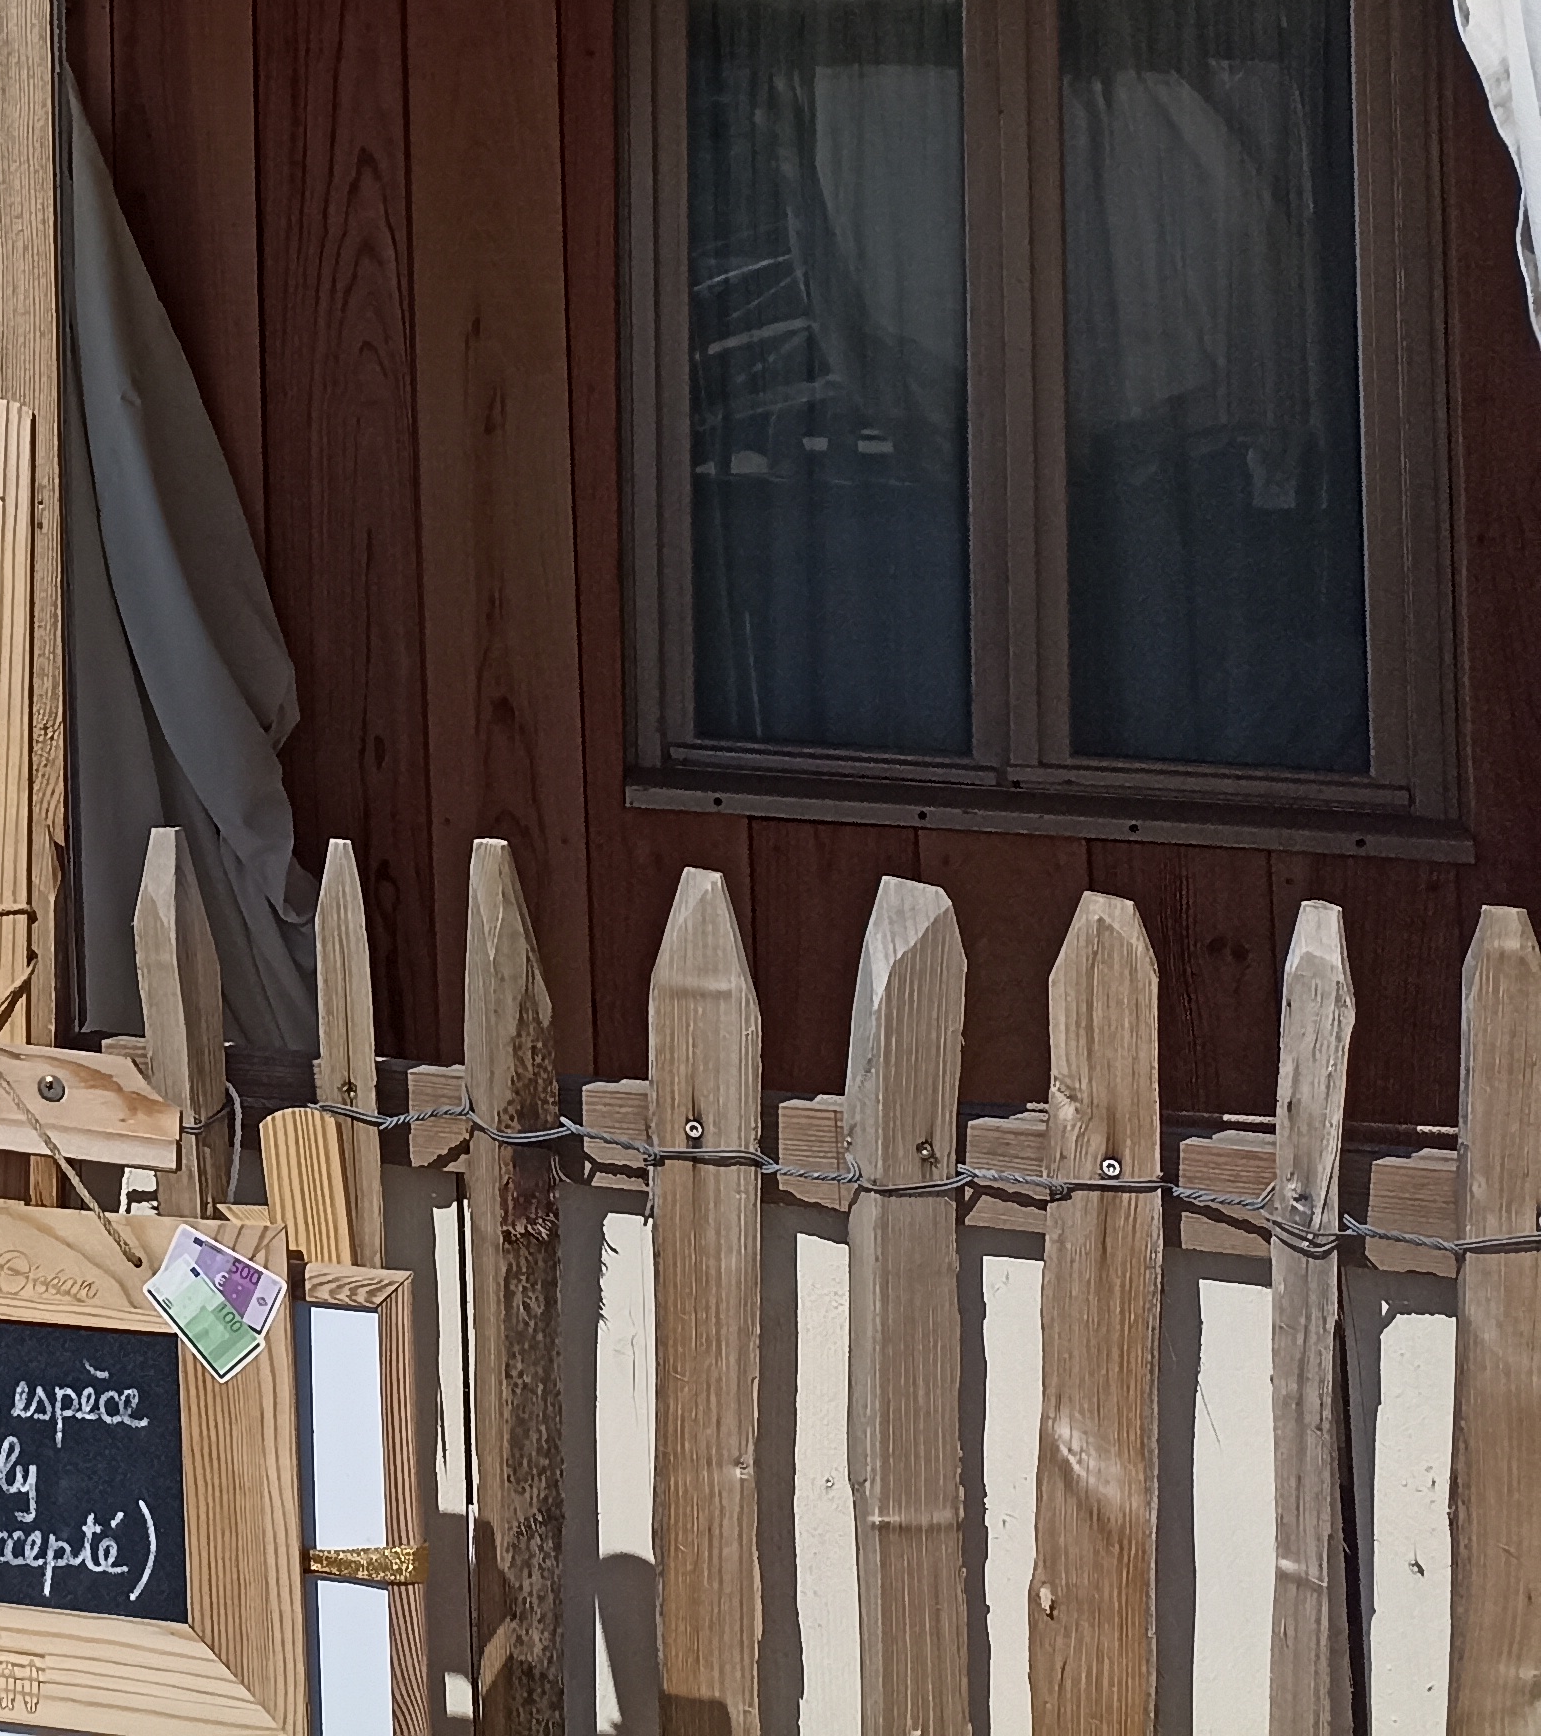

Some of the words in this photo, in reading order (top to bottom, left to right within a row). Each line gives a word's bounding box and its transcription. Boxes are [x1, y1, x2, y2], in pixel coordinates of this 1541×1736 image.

[230, 1259, 263, 1286] 500
[216, 1303, 243, 1333] 100
[11, 1358, 150, 1448] espèce
